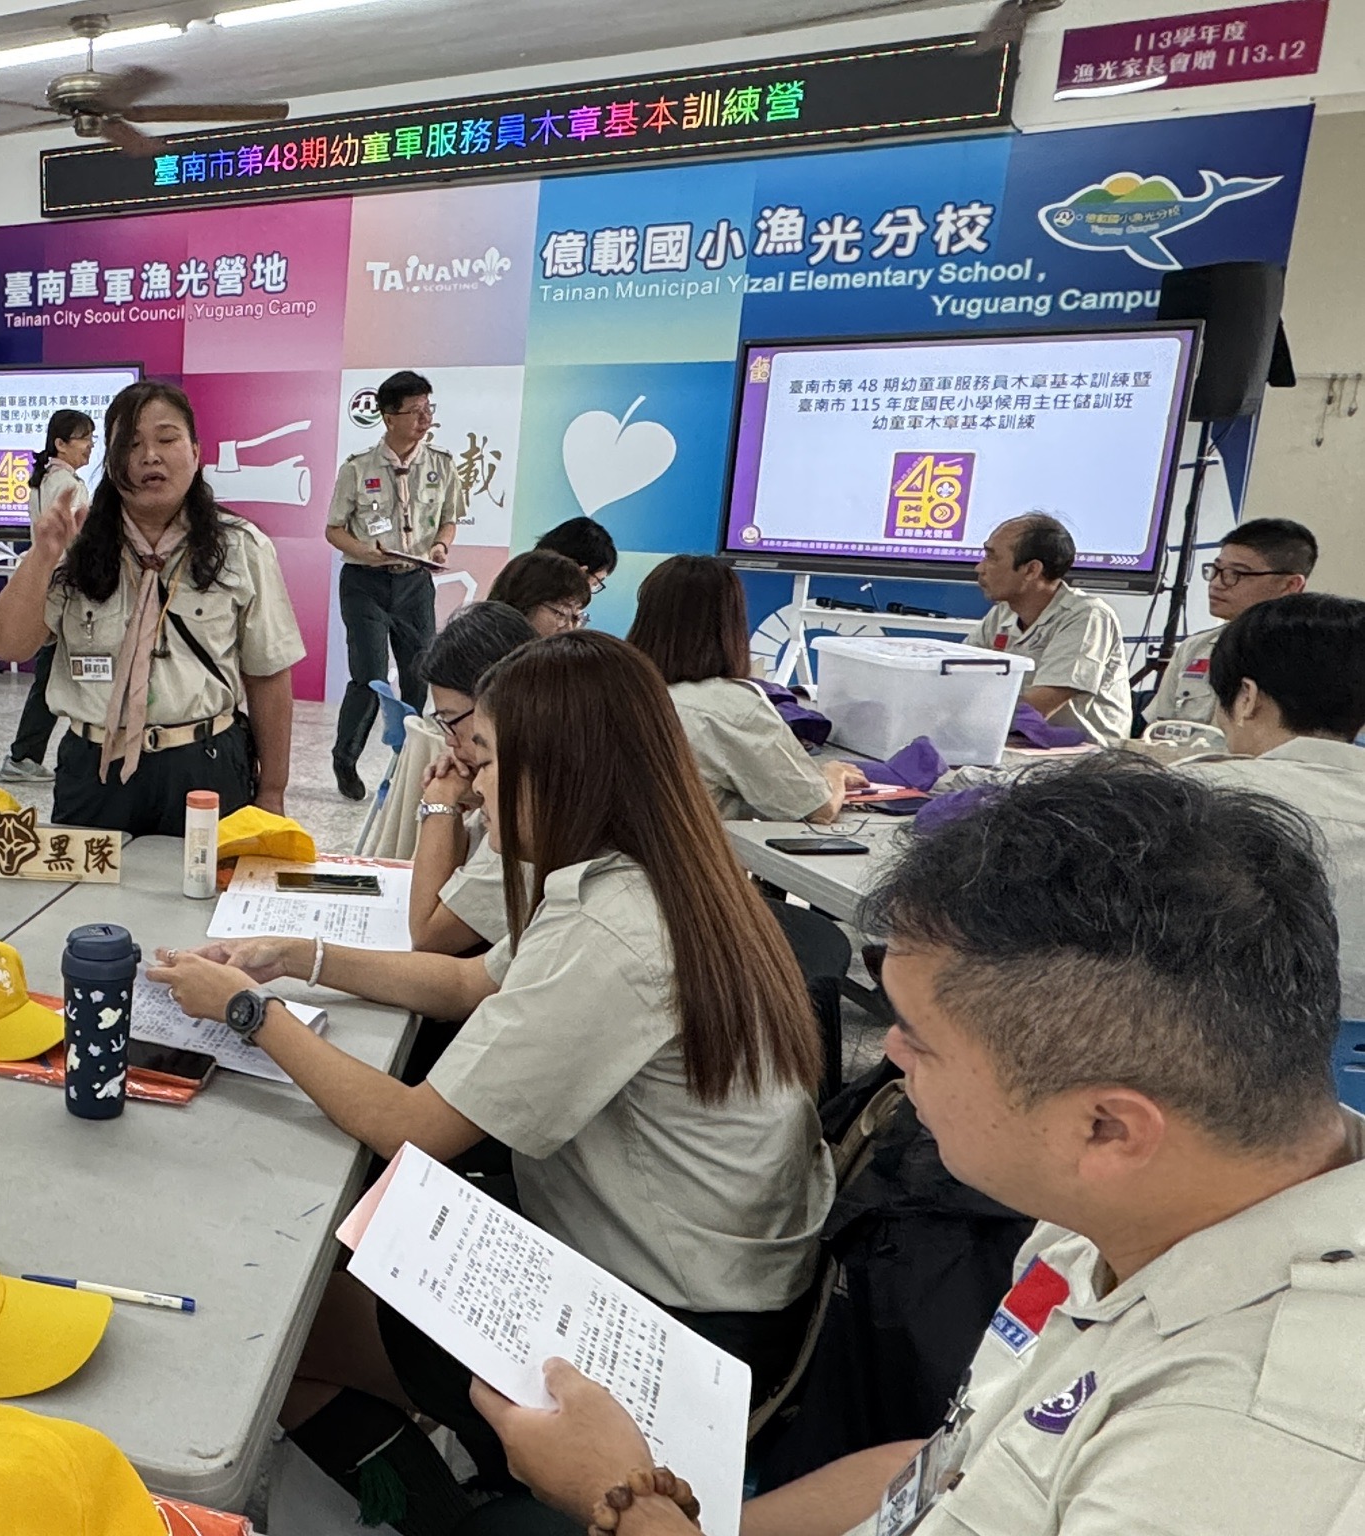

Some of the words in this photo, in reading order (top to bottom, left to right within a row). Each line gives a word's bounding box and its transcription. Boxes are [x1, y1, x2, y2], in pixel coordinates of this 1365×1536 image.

[1135, 20, 1248, 51] 113學年度
[1072, 48, 1216, 83] 漁光家長會贈
[1227, 40, 1306, 67] 113.12
[153, 80, 805, 186] 臺南市第48期幼童軍服務員木章基本訓練營
[541, 201, 994, 278] 億載國小漁光分校
[4, 251, 289, 308] 臺南童軍漁光營地
[540, 284, 610, 302] Tainan
[616, 278, 720, 300] Municipal
[727, 273, 784, 293] Yizai
[789, 267, 935, 292] Elementary
[4, 311, 51, 328] Tainan
[53, 309, 81, 328] City
[84, 307, 126, 324] Scout
[132, 305, 185, 323] Council
[268, 299, 317, 317] Camp
[932, 294, 1052, 320] Yuguang
[1058, 288, 1161, 314] Campu
[789, 378, 853, 394] 臺南市第
[857, 378, 879, 393] 48
[797, 398, 846, 413] 臺南市
[850, 398, 881, 412] 115
[42, 834, 119, 875] 黑隊
